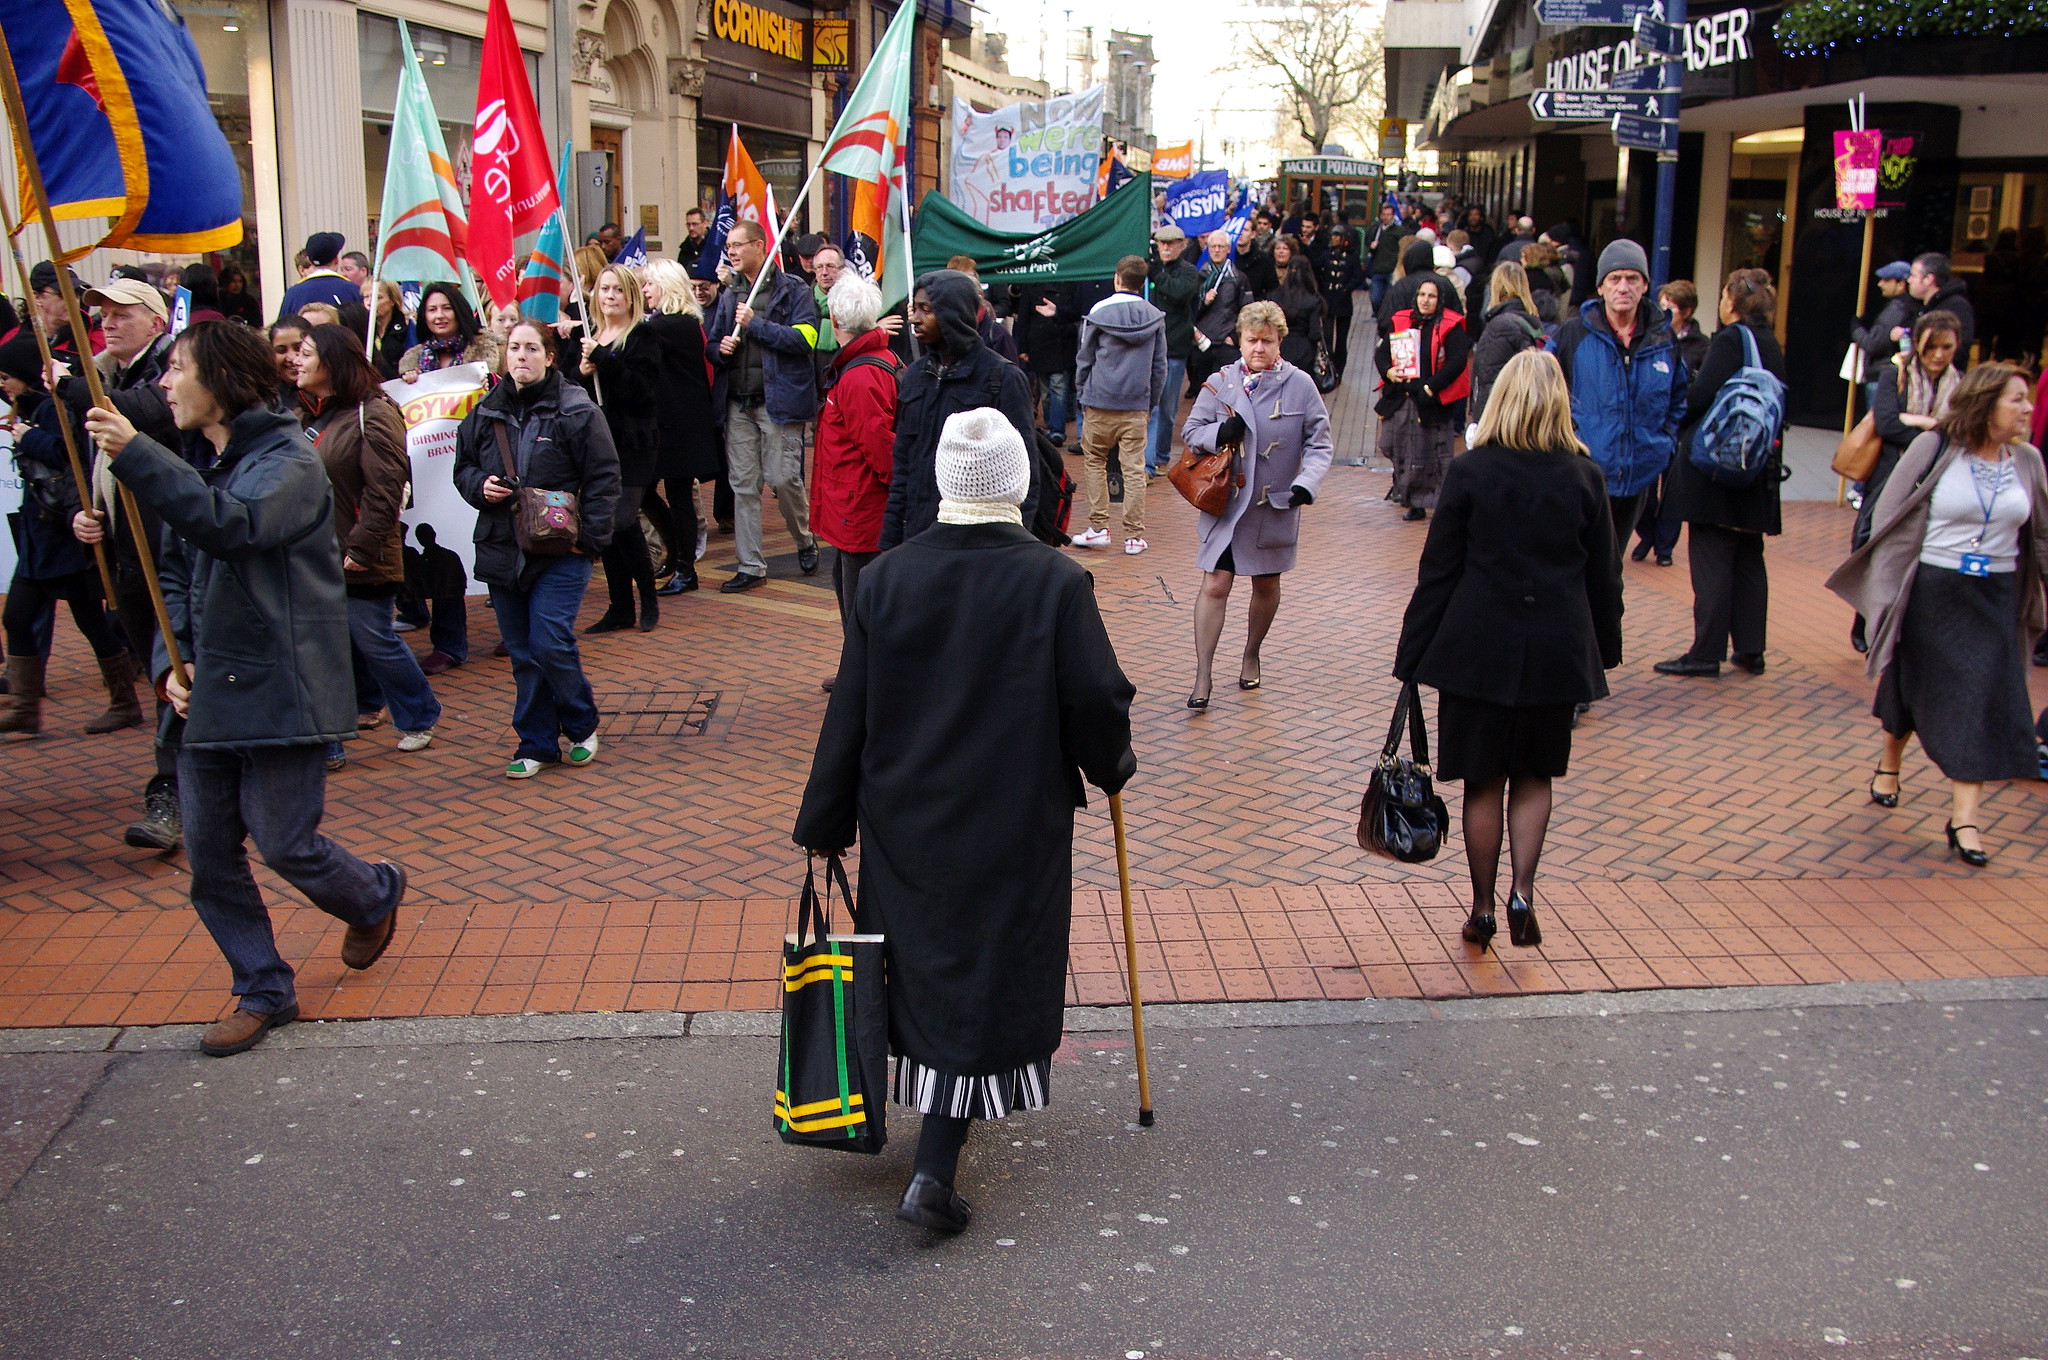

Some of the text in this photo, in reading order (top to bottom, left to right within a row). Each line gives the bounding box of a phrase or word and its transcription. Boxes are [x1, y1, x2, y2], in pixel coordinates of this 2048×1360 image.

[714, 0, 790, 57] CORNISH
[813, 19, 849, 27] CORNISH
[1546, 45, 1611, 90] HOUSE
[1647, 7, 1749, 72] ASER
[1008, 146, 1098, 184] being
[1285, 160, 1378, 177] JACKET POTATOES
[989, 180, 1096, 223] shafted
[1170, 191, 1226, 221] NASUW
[1030, 262, 1059, 275] Party
[412, 428, 458, 446] BIRMING
[427, 444, 456, 458] BRAN
